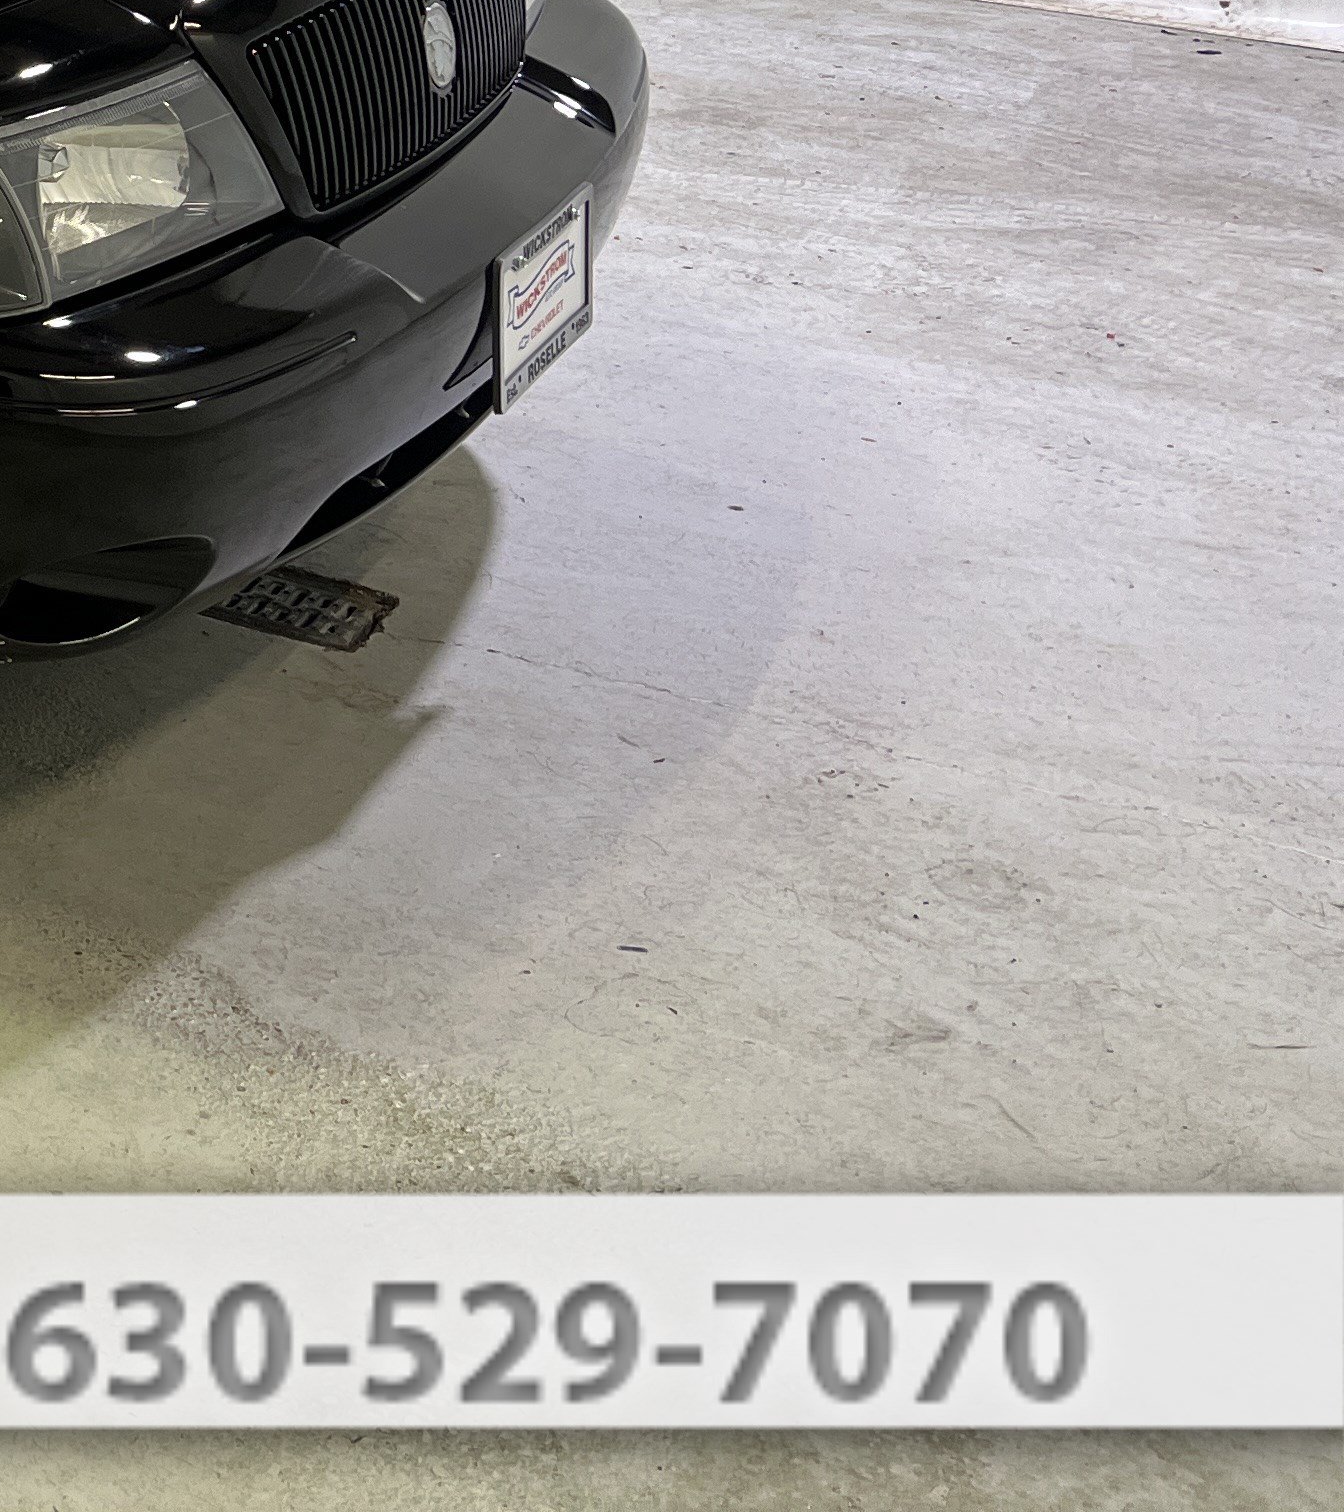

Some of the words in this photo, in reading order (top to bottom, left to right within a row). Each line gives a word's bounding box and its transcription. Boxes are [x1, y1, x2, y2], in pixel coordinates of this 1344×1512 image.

[523, 203, 573, 260] WICKSTROM
[516, 250, 568, 320] WICKSTROM
[527, 330, 567, 384] ROSELLE
